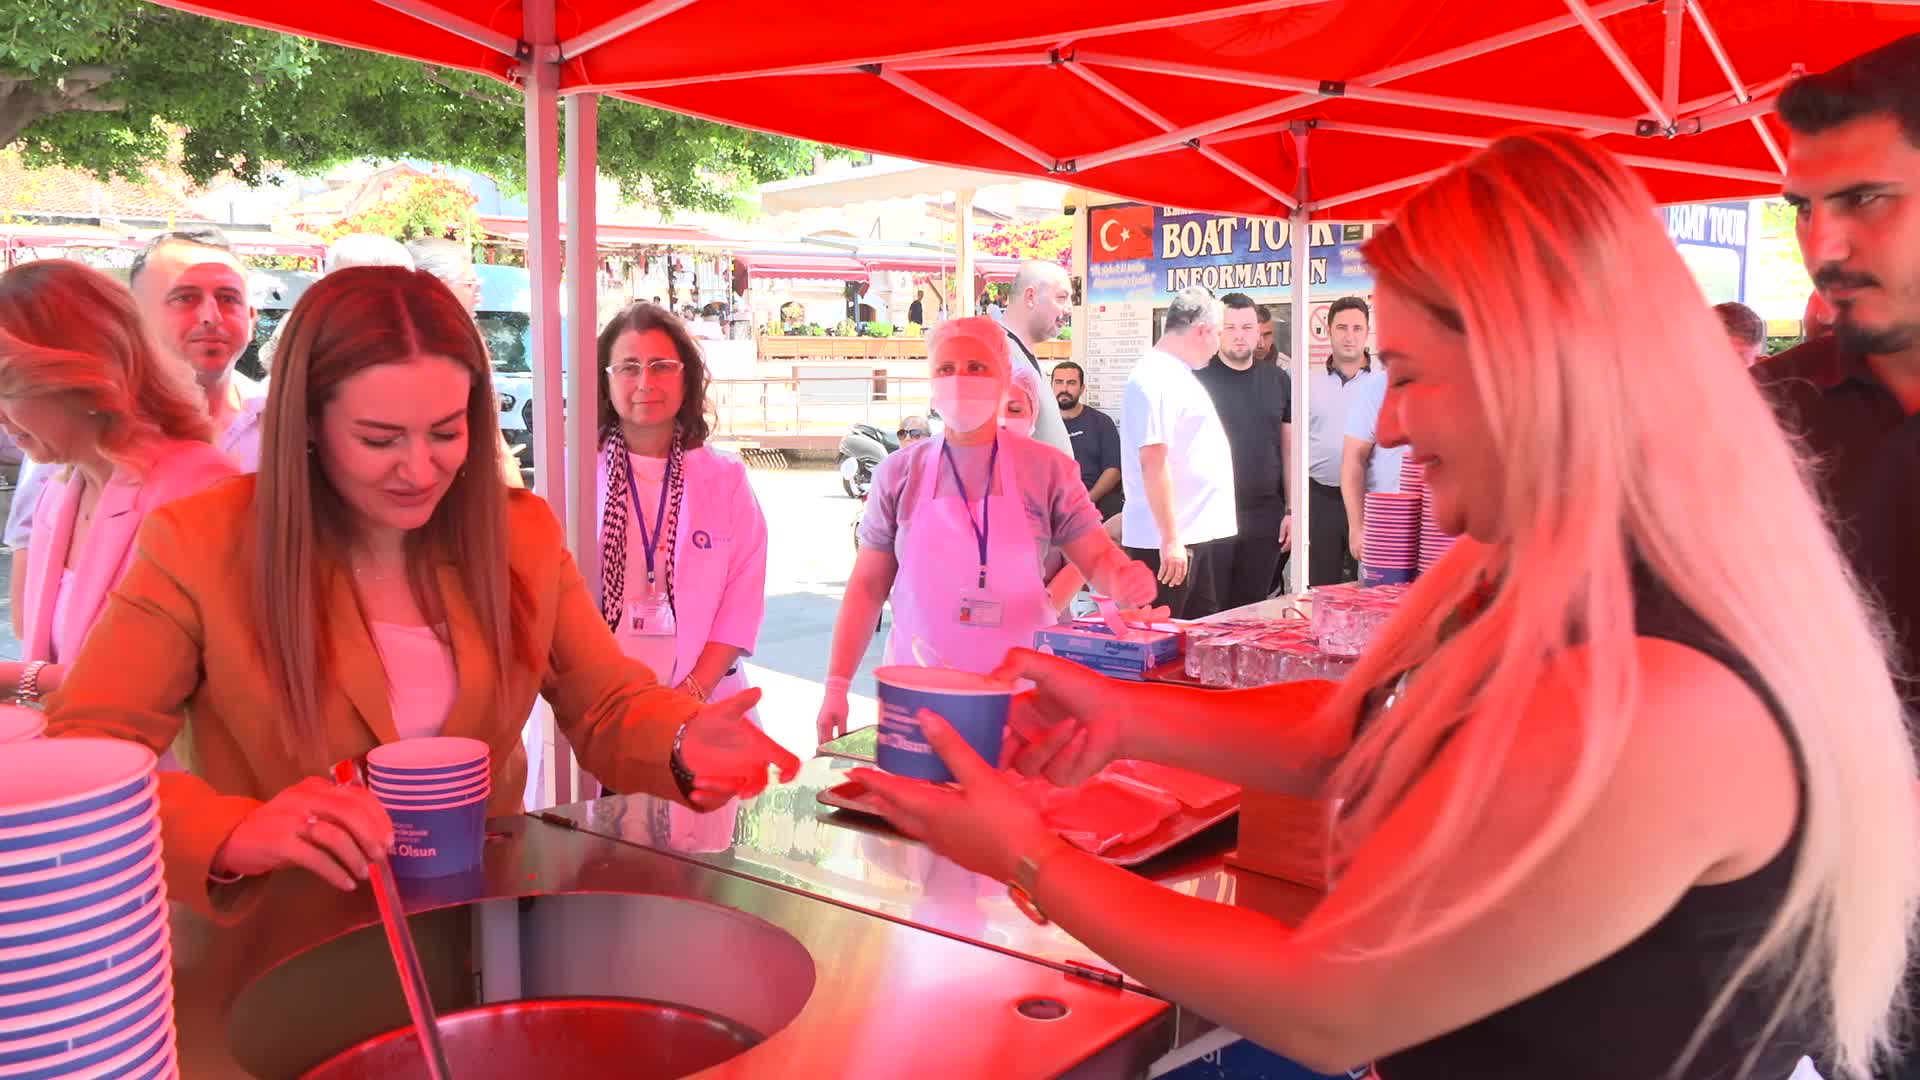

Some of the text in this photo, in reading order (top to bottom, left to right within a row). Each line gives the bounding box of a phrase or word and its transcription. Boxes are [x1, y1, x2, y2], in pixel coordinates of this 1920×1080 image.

[1162, 217, 1334, 258] BOAT TOR
[1668, 205, 1706, 240] BOAT
[1167, 258, 1326, 291] INFORMATIN
[399, 844, 437, 857] Olsun
